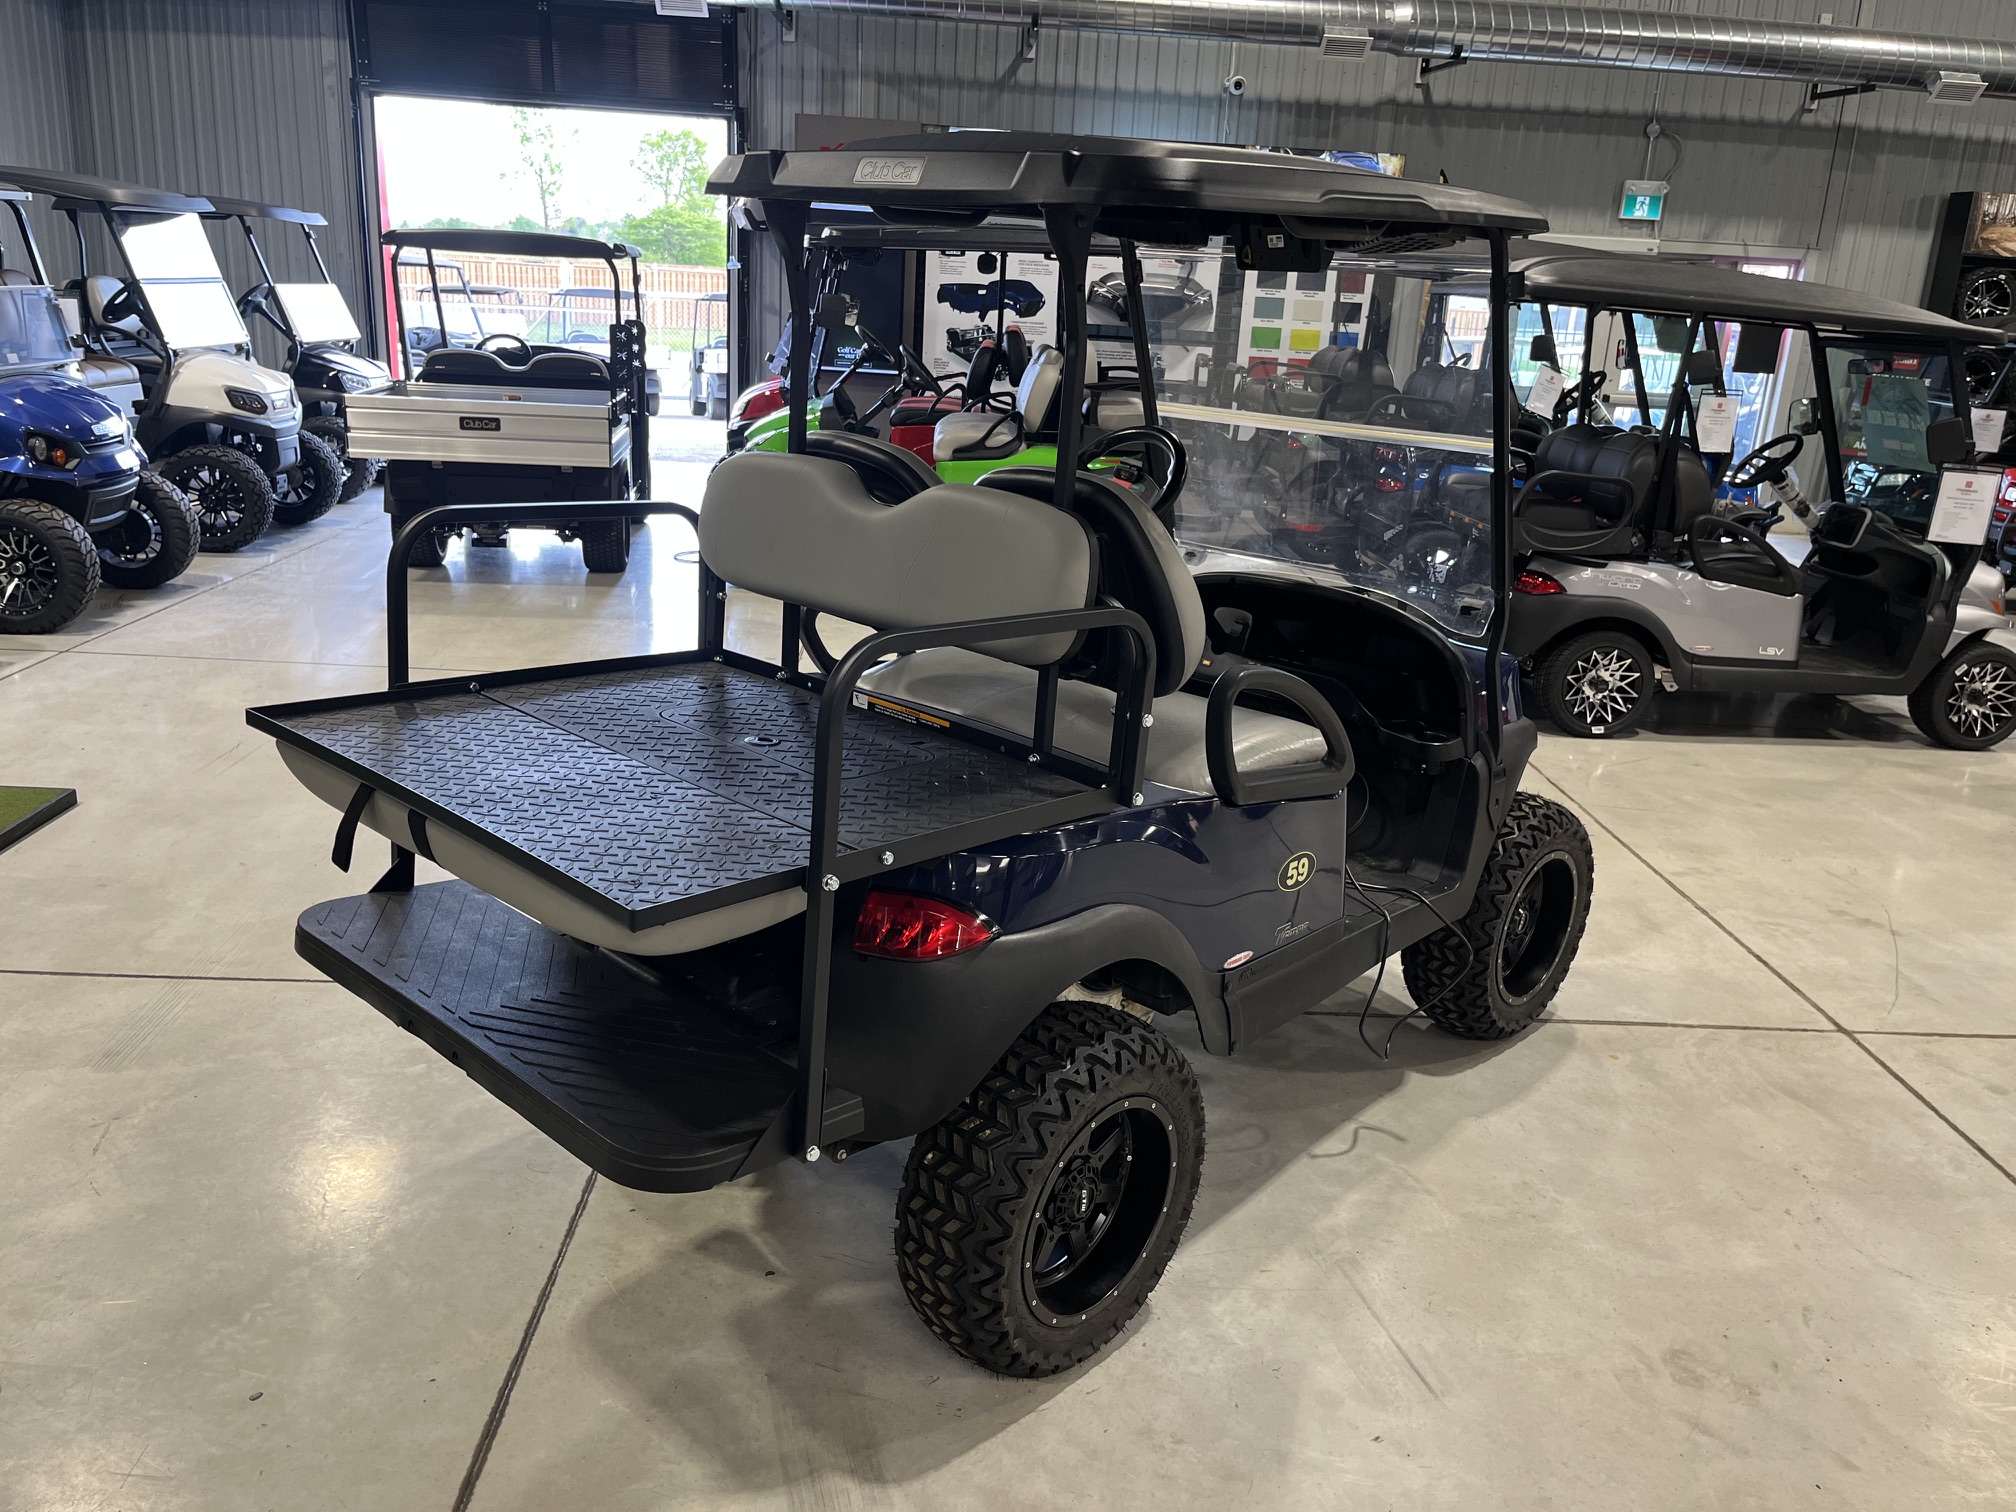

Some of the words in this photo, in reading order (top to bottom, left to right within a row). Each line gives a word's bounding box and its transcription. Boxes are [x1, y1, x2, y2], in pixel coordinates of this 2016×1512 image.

[861, 161, 891, 180] Club
[892, 161, 918, 180] Car
[837, 346, 851, 354] Golf
[463, 419, 482, 429] Club
[482, 420, 497, 429] Car
[1758, 646, 1784, 656] LSV
[1286, 857, 1309, 886] 59
